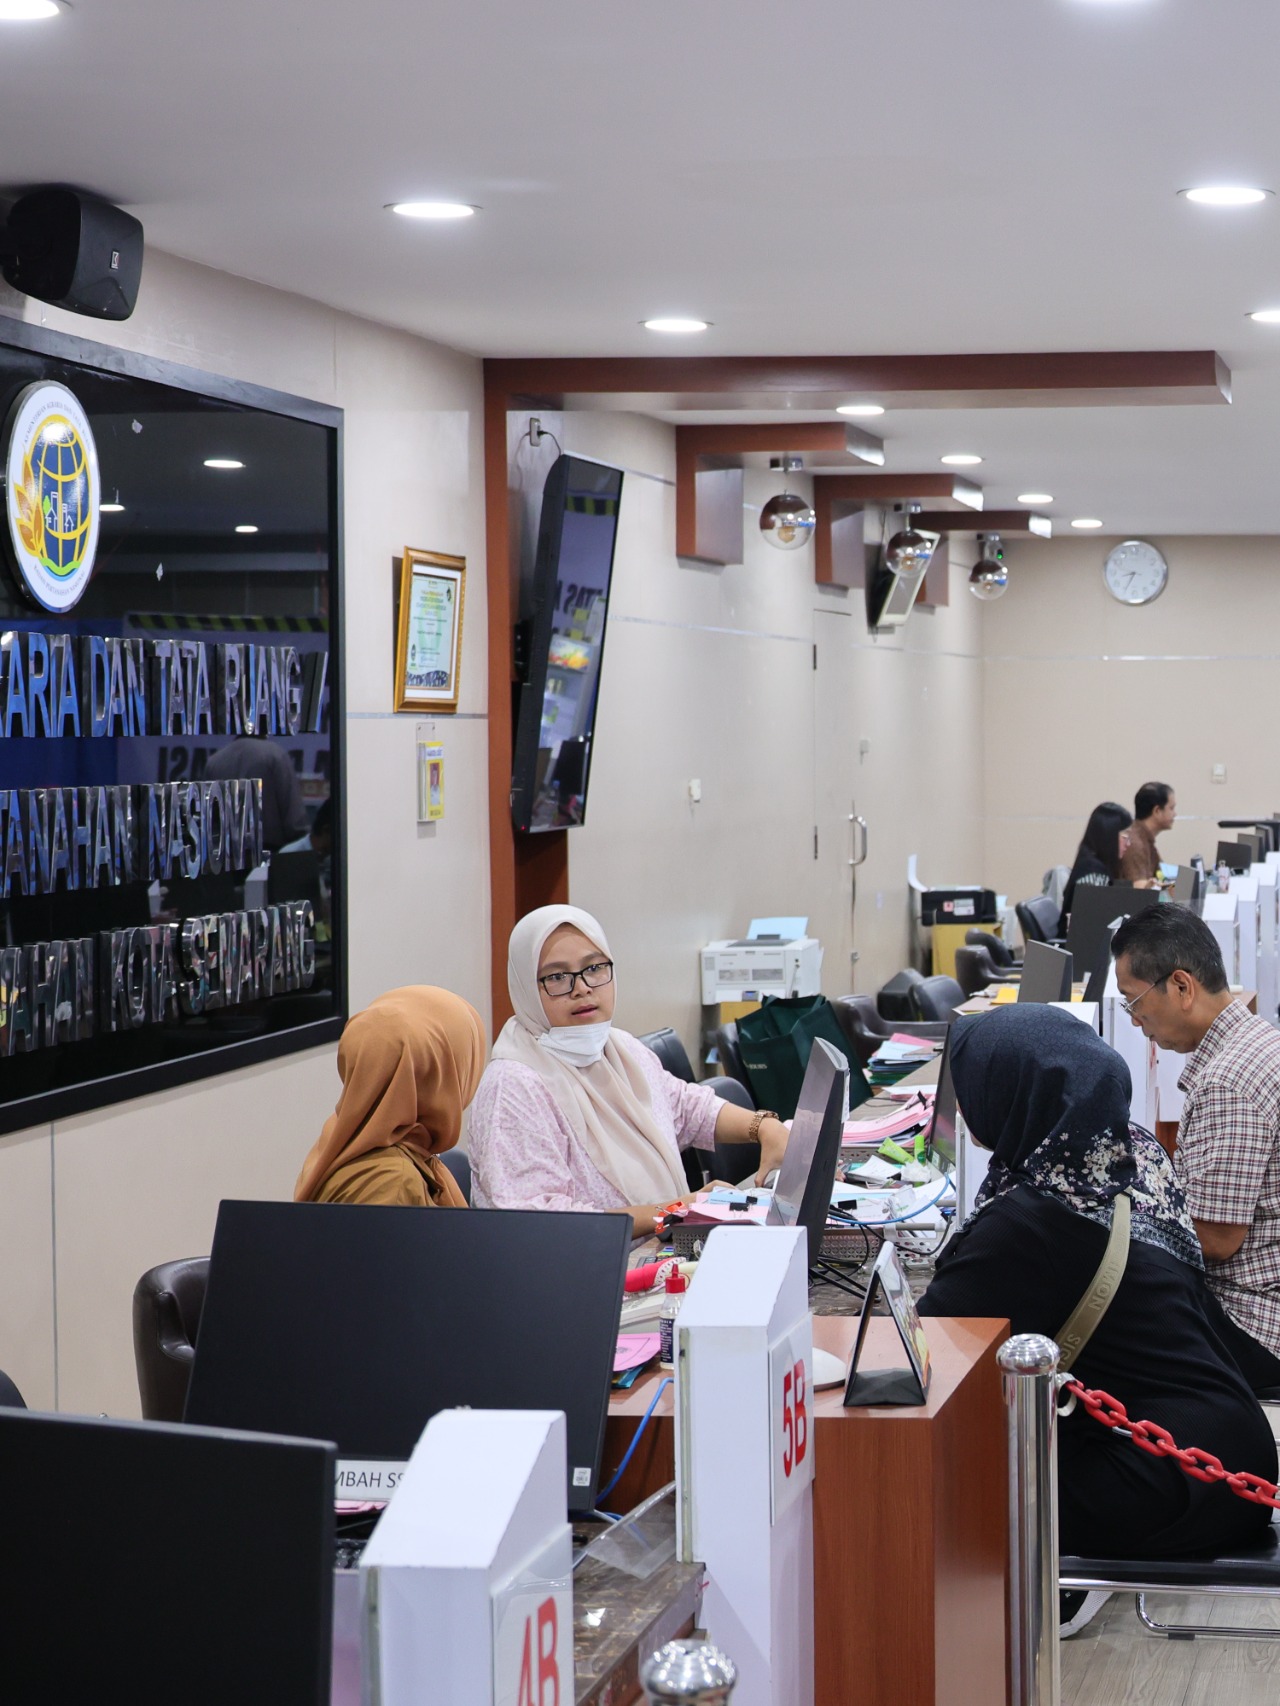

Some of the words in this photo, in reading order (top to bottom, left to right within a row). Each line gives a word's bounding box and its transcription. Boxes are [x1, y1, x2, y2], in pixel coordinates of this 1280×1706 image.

[0, 630, 81, 738] ARIA
[88, 635, 146, 738] DAN
[153, 639, 213, 736] TATA
[225, 643, 301, 736] RUANG
[149, 778, 271, 880] NASIONAL
[110, 926, 179, 1033] KOTA
[181, 900, 315, 1016] SEMARANG
[783, 1358, 807, 1478] 5B
[518, 1596, 560, 1706] 4B
